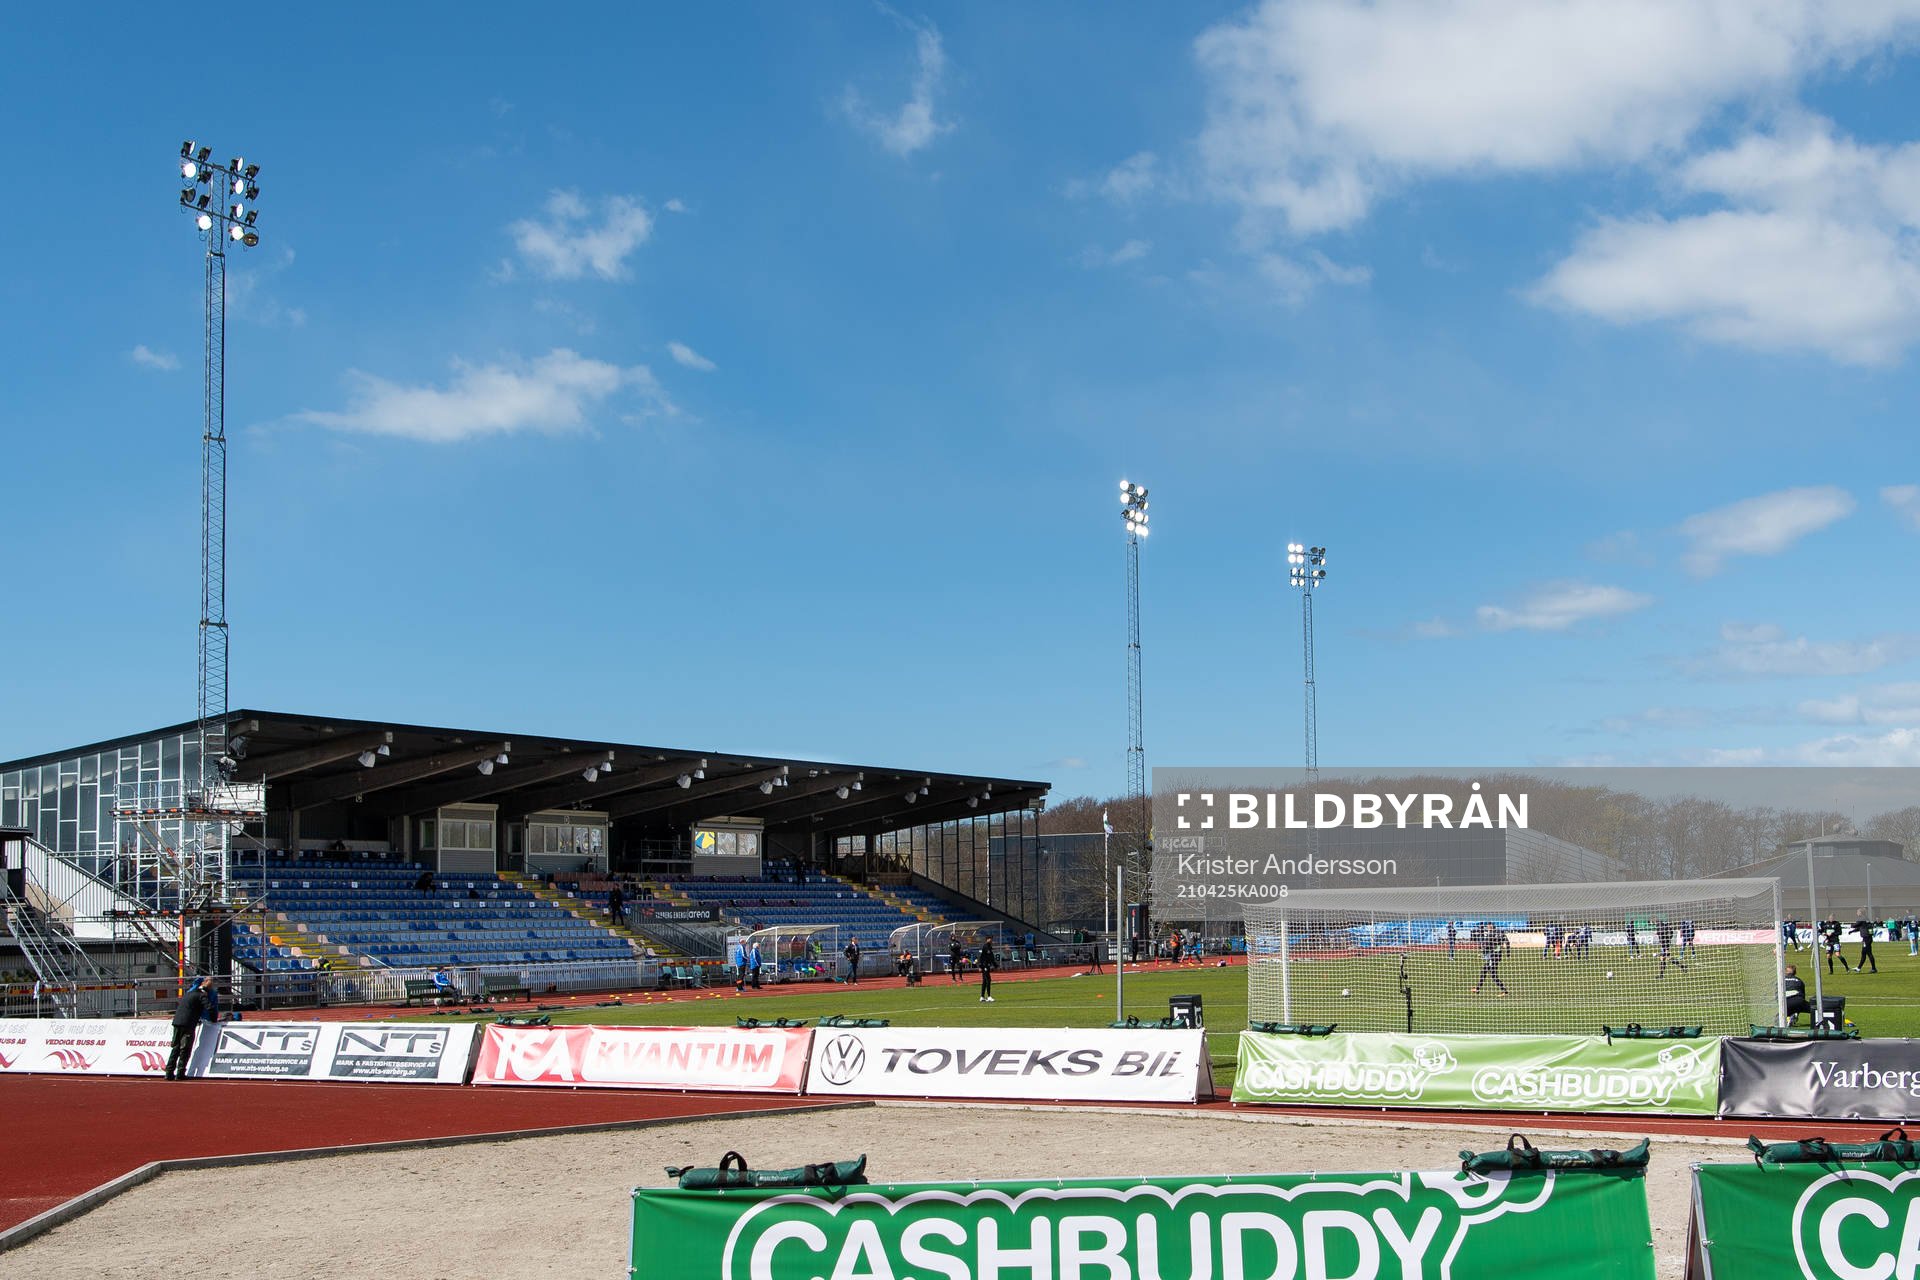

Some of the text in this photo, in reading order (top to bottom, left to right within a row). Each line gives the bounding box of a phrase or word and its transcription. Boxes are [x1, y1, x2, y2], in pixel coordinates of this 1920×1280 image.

[688, 910, 710, 919] arena
[1603, 932, 1654, 945] coloma
[596, 1041, 775, 1073] KVANTUM
[882, 1048, 1104, 1077] TOVEKS
[1250, 1064, 1426, 1093] CASHBUDDY
[1478, 1071, 1672, 1099] CASHBUDDY
[1810, 1061, 1920, 1098] Varberg
[750, 1207, 1442, 1280] CASHBUDDY
